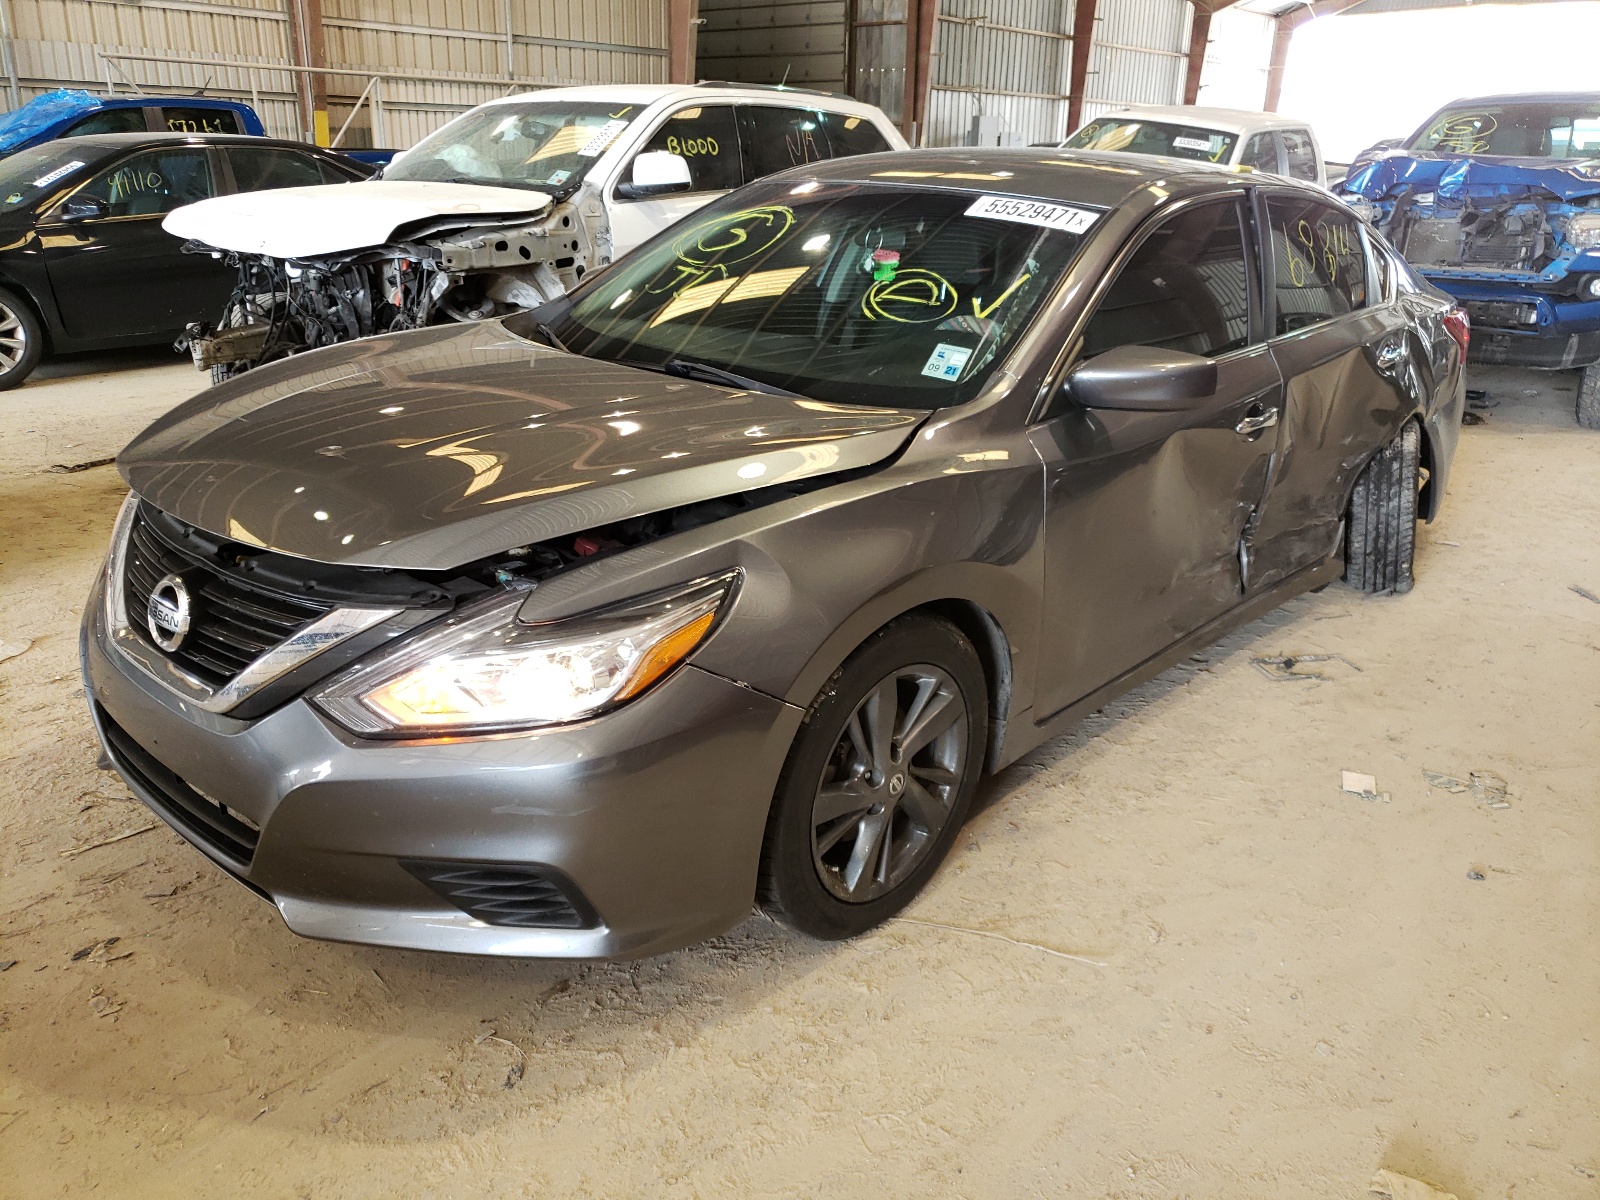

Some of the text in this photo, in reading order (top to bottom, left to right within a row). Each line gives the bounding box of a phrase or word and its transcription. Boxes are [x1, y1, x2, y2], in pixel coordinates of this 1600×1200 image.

[667, 136, 719, 157] BLOOD
[927, 363, 957, 376] 09 21
[150, 603, 179, 628] SSAN
